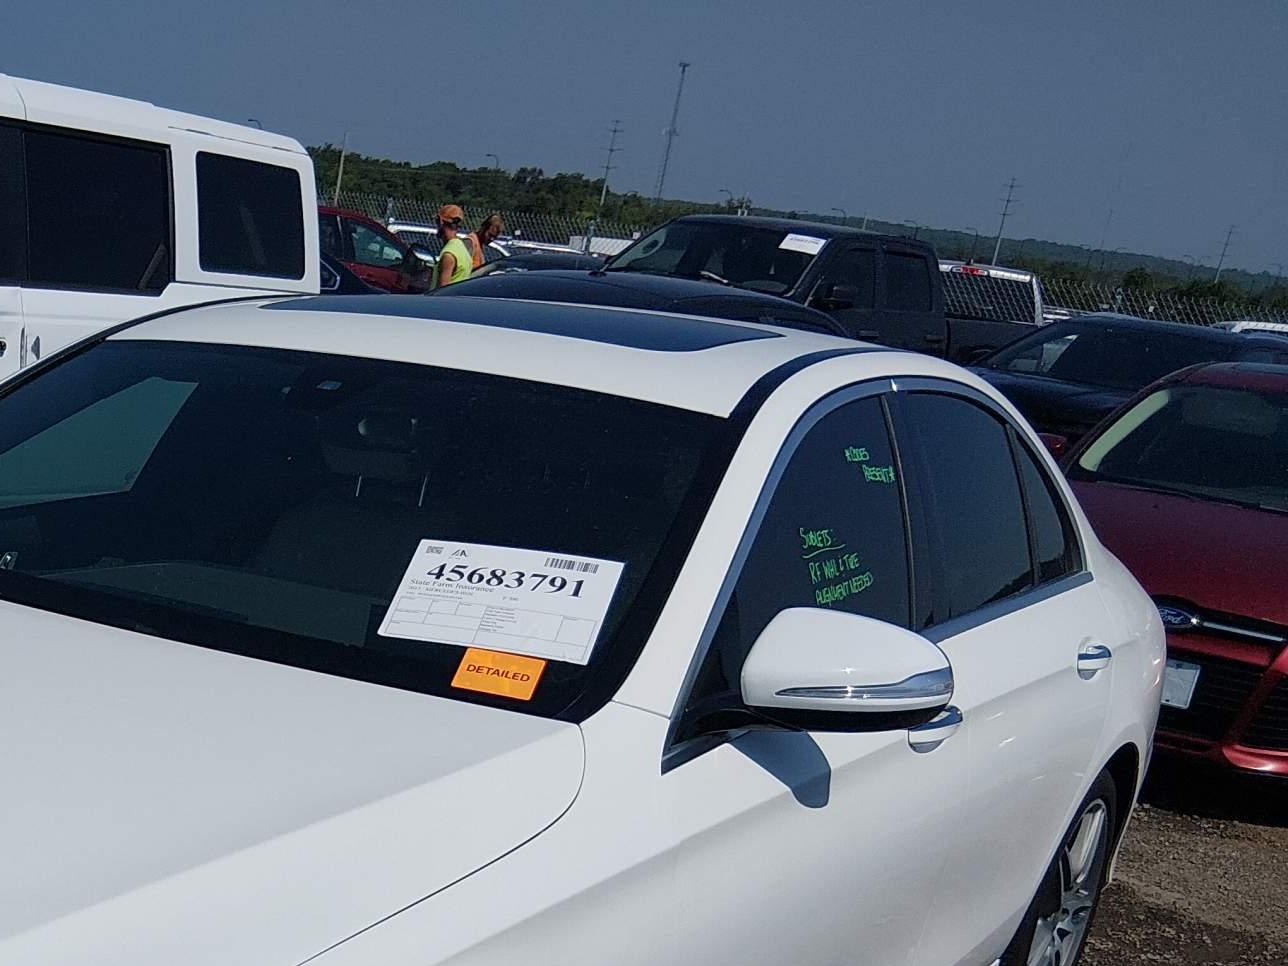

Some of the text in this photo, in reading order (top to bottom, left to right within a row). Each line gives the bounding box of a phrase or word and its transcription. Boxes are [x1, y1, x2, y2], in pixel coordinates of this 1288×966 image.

[426, 562, 585, 598] 45683791
[808, 561, 822, 584] RF
[432, 580, 453, 588] Farm
[455, 583, 495, 593] Insurance
[466, 663, 531, 683] DETAILED
